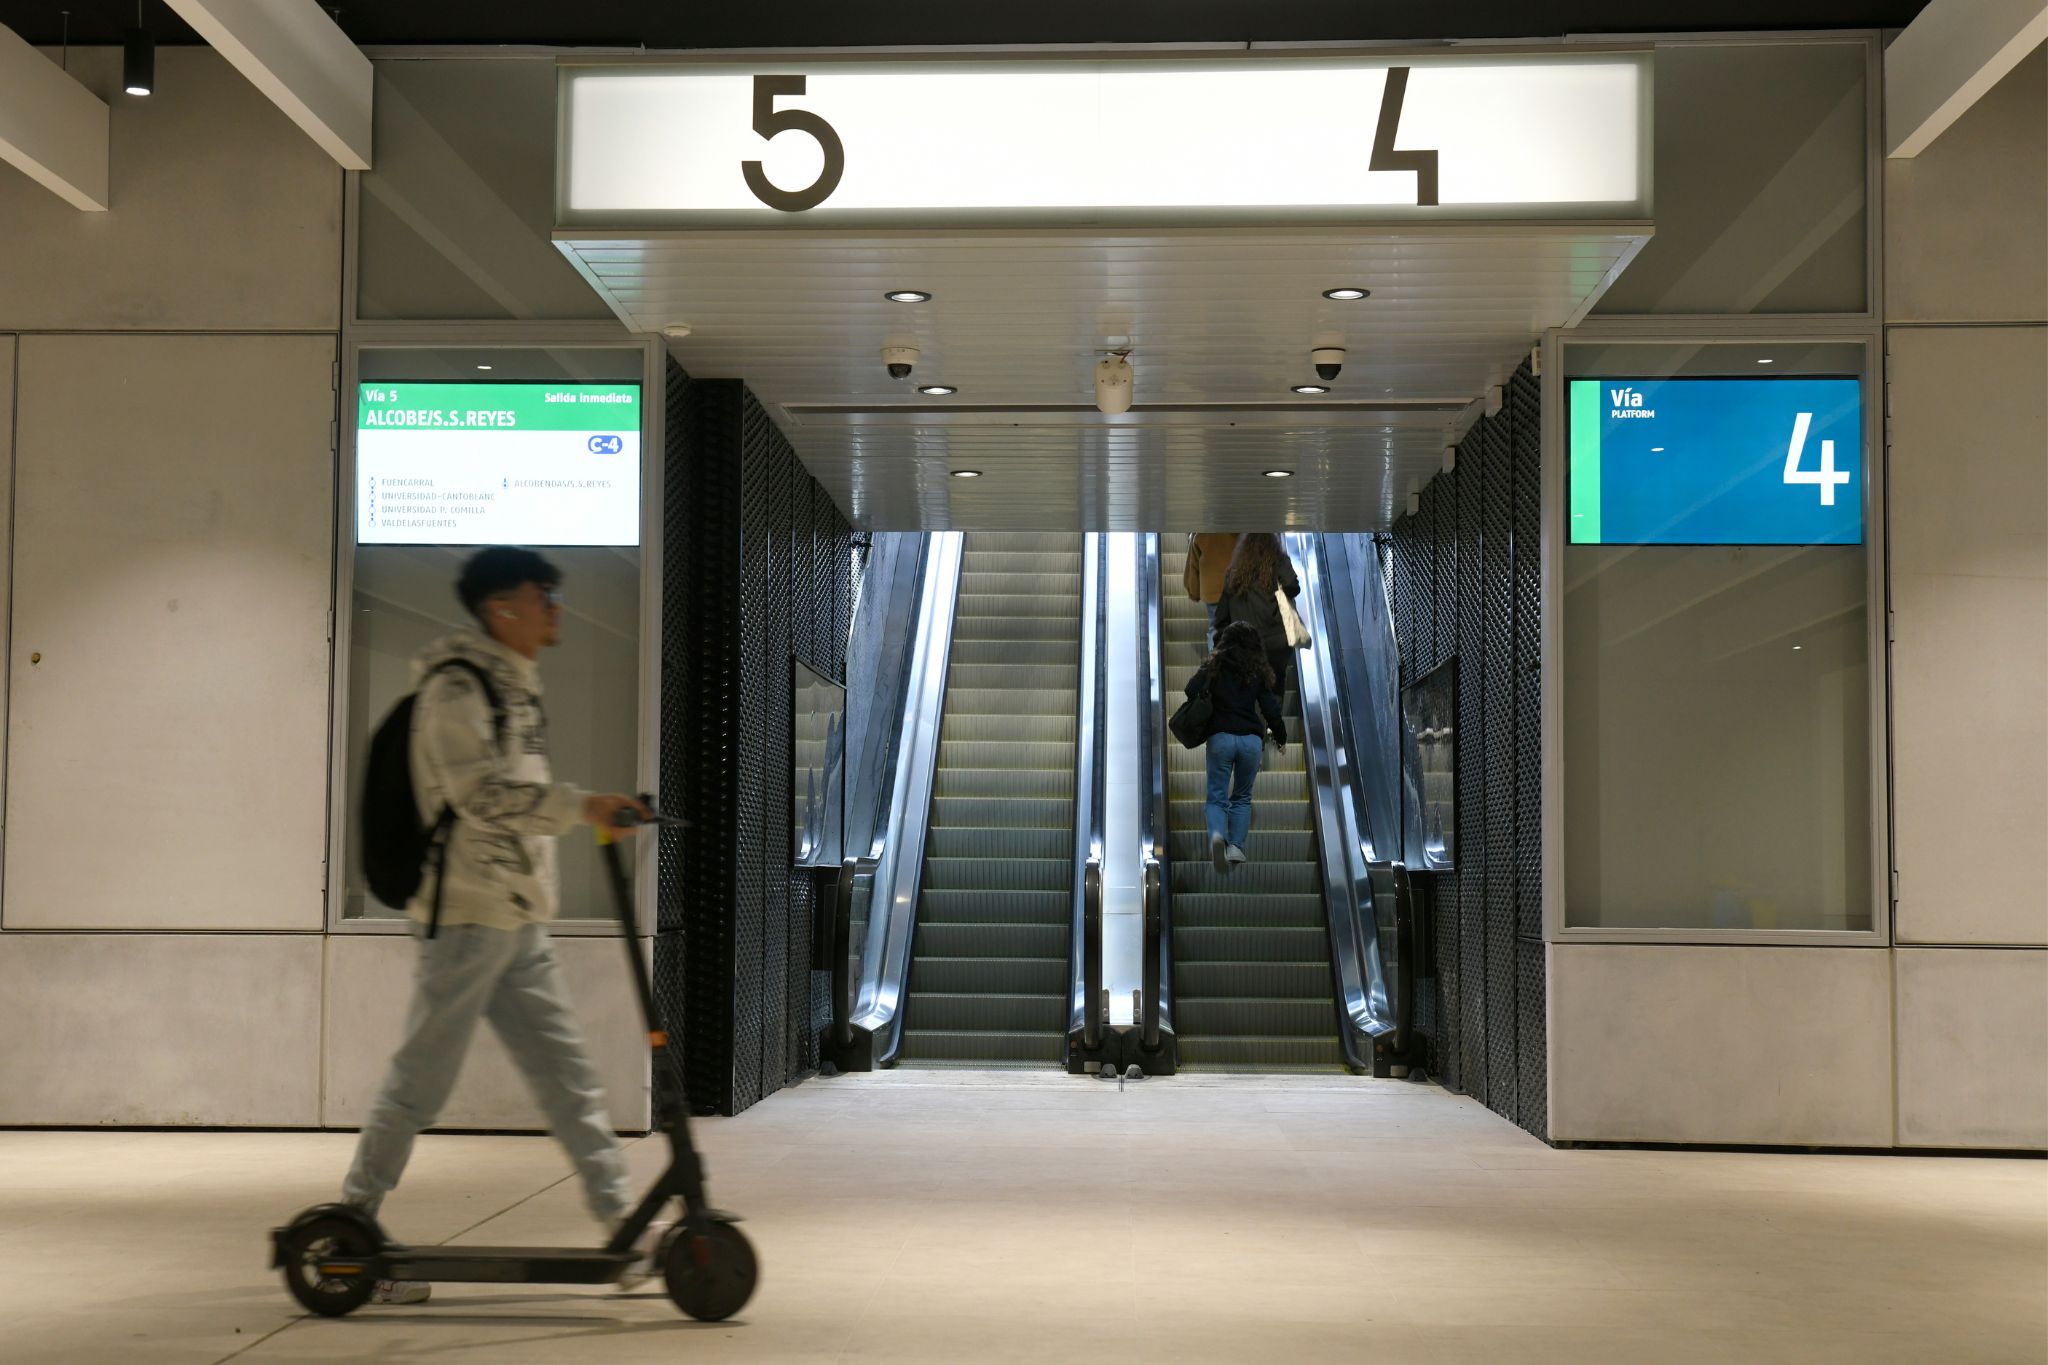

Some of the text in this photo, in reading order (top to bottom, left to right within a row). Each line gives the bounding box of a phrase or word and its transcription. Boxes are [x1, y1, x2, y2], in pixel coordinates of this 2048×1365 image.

[741, 75, 845, 211] 5
[1368, 67, 1439, 206] 4
[365, 389, 398, 402] Vía 5
[545, 391, 633, 404] Salida inmediata
[1611, 388, 1643, 407] Vía
[365, 409, 516, 427] ALCOBE/S.S.REYES
[1611, 409, 1655, 418] PLATFORM
[590, 437, 620, 454] C-4
[1783, 412, 1850, 506] 4
[381, 478, 434, 487] FUENCARRAL
[381, 505, 437, 514] UNIVERSIDAD
[381, 519, 457, 527] VALDELASFUENTES
